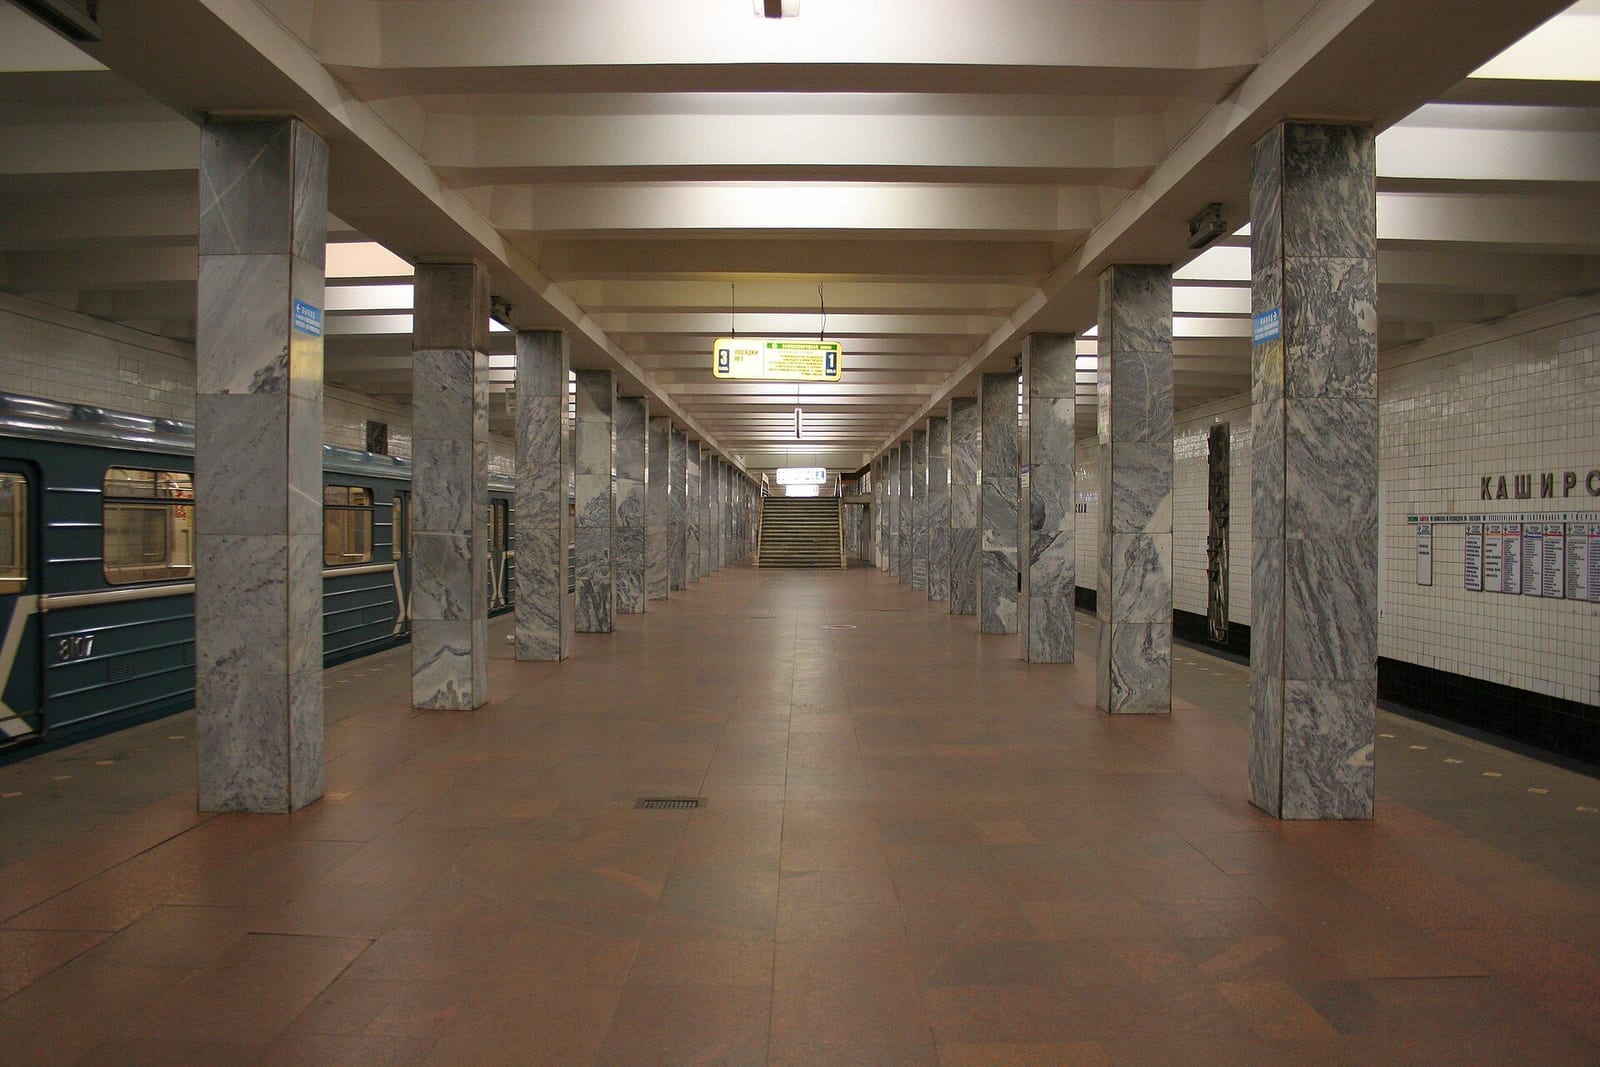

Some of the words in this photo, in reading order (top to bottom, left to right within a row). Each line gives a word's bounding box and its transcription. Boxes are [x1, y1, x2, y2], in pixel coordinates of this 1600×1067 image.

[720, 350, 728, 365] 3
[828, 353, 835, 368] 1
[1480, 469, 1600, 500] КАШИРС
